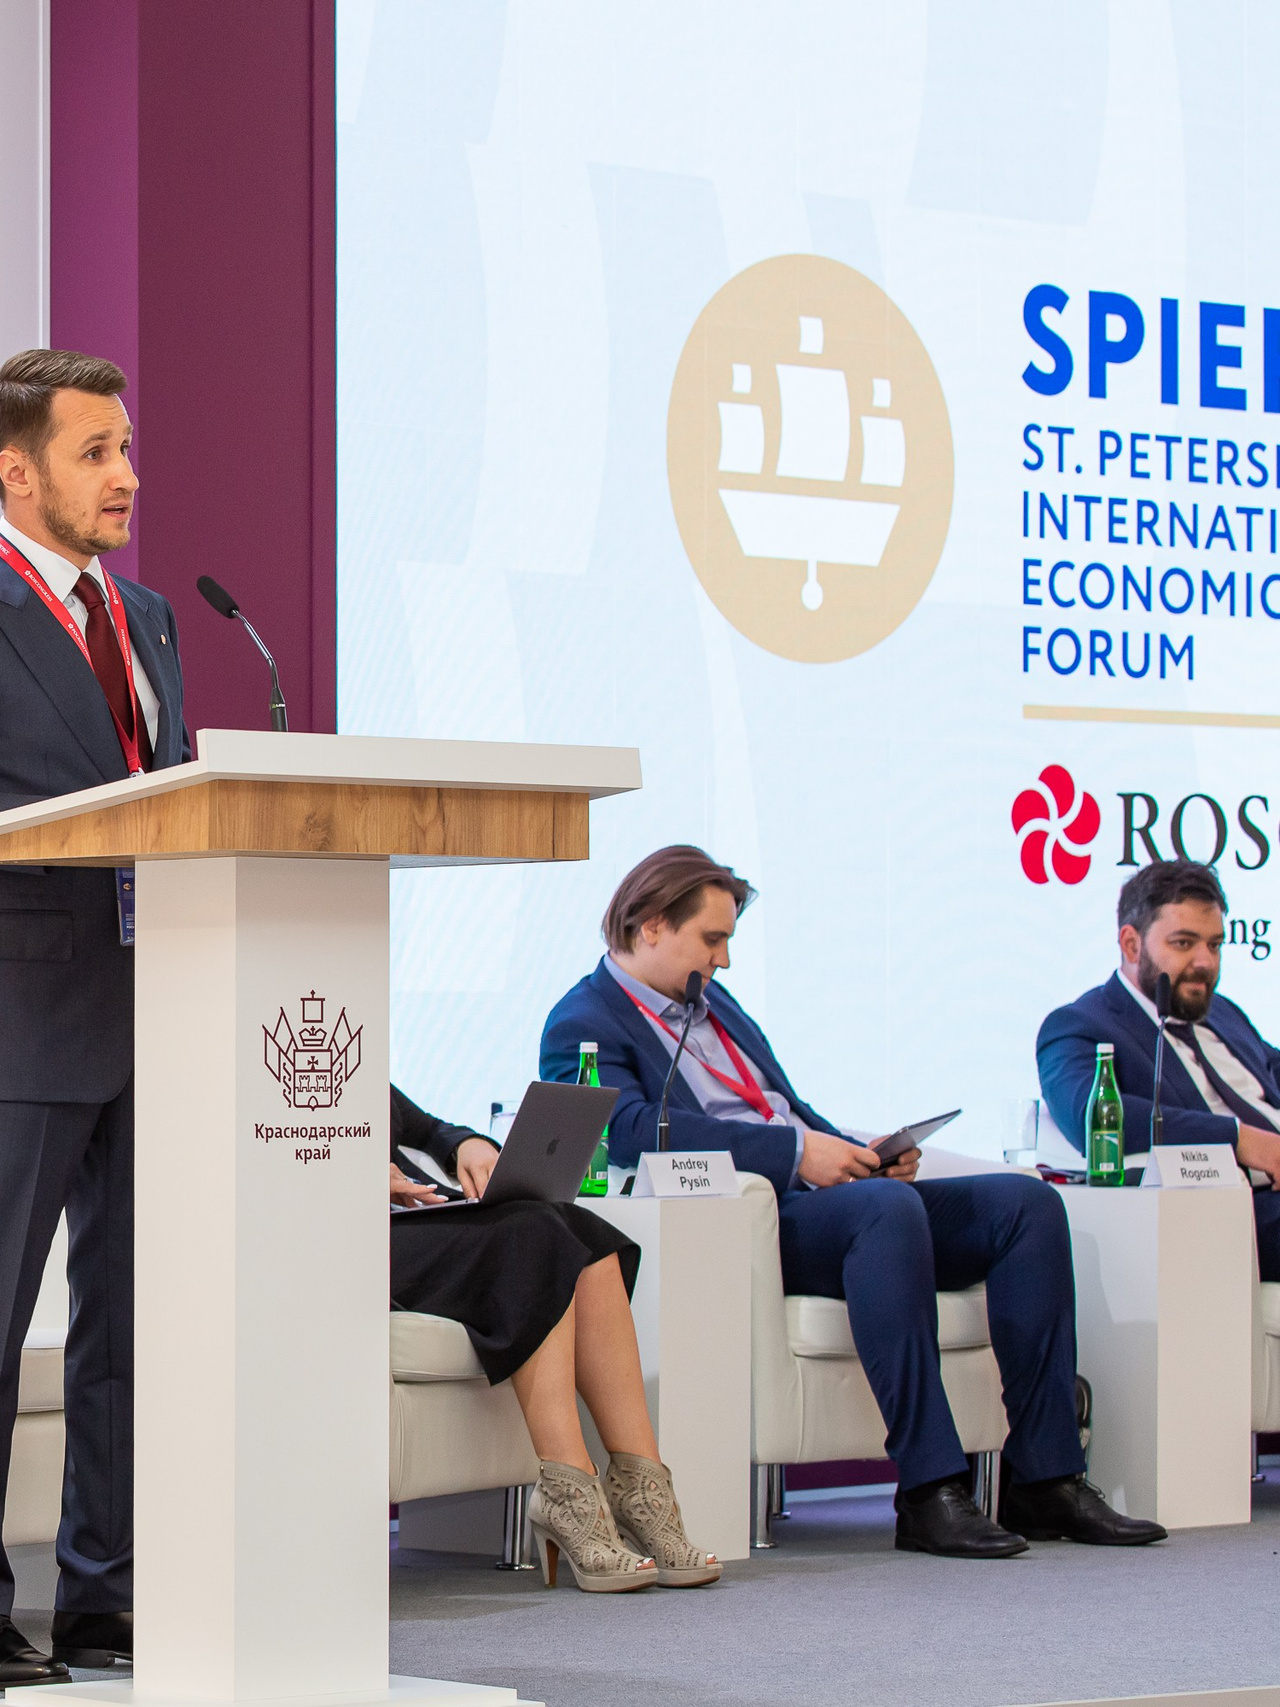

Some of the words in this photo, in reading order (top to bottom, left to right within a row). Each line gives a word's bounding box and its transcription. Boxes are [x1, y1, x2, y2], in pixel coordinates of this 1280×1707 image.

[1023, 423, 1082, 474] ST.
[1099, 429, 1280, 489] PETERS
[1023, 626, 1194, 681] FORUM
[1116, 792, 1280, 870] ROS
[255, 1122, 371, 1143] Краснодарский
[295, 1144, 331, 1165] край
[671, 1158, 708, 1172] Andrey
[1181, 1151, 1209, 1162] Nikita
[679, 1175, 710, 1191] Pysin
[1180, 1167, 1220, 1181] Rogozin
